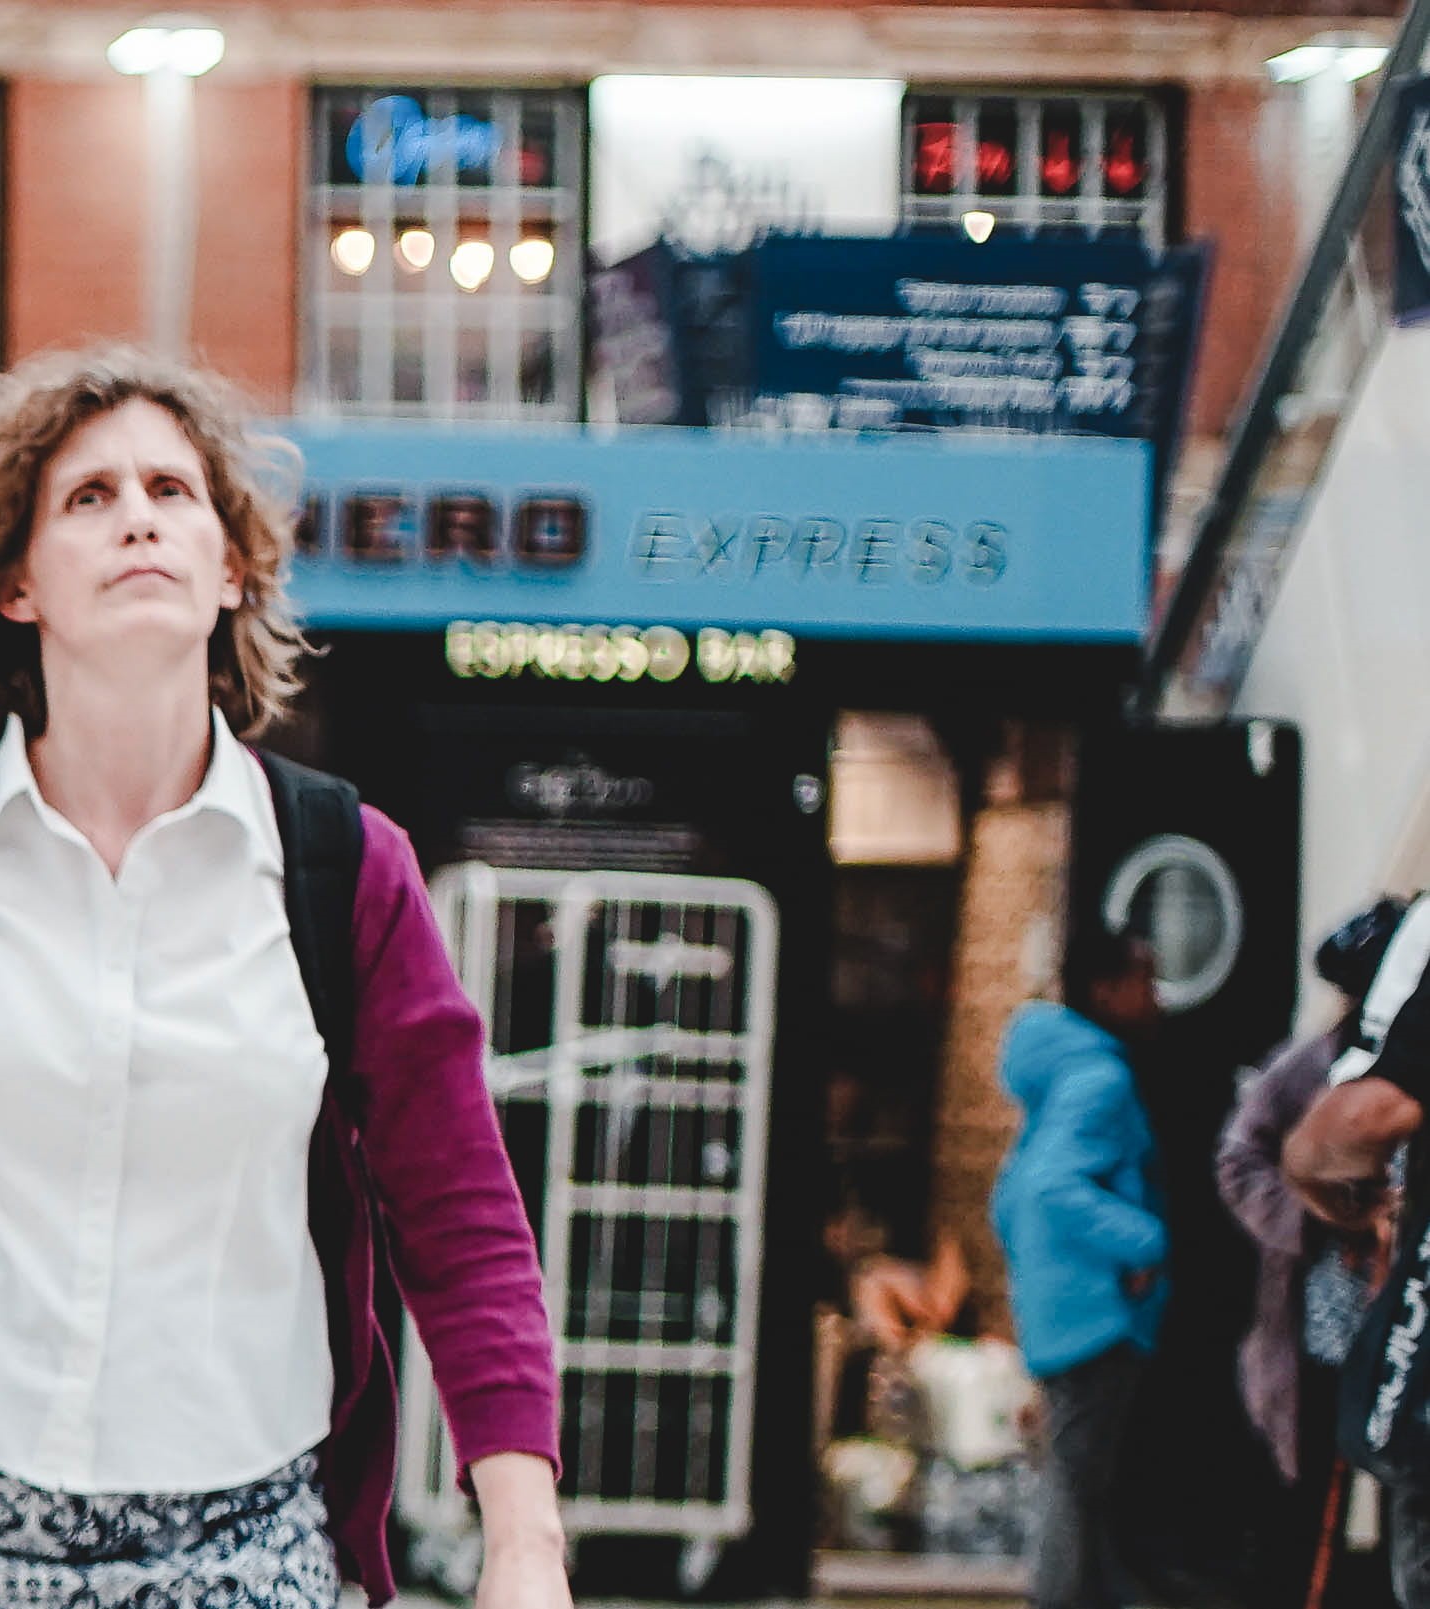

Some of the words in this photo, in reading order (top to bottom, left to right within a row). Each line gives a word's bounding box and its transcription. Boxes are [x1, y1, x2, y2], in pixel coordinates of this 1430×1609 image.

[628, 511, 1009, 590] EXPRESS
[445, 620, 690, 684] ESPRESSO
[697, 627, 796, 685] BAR
